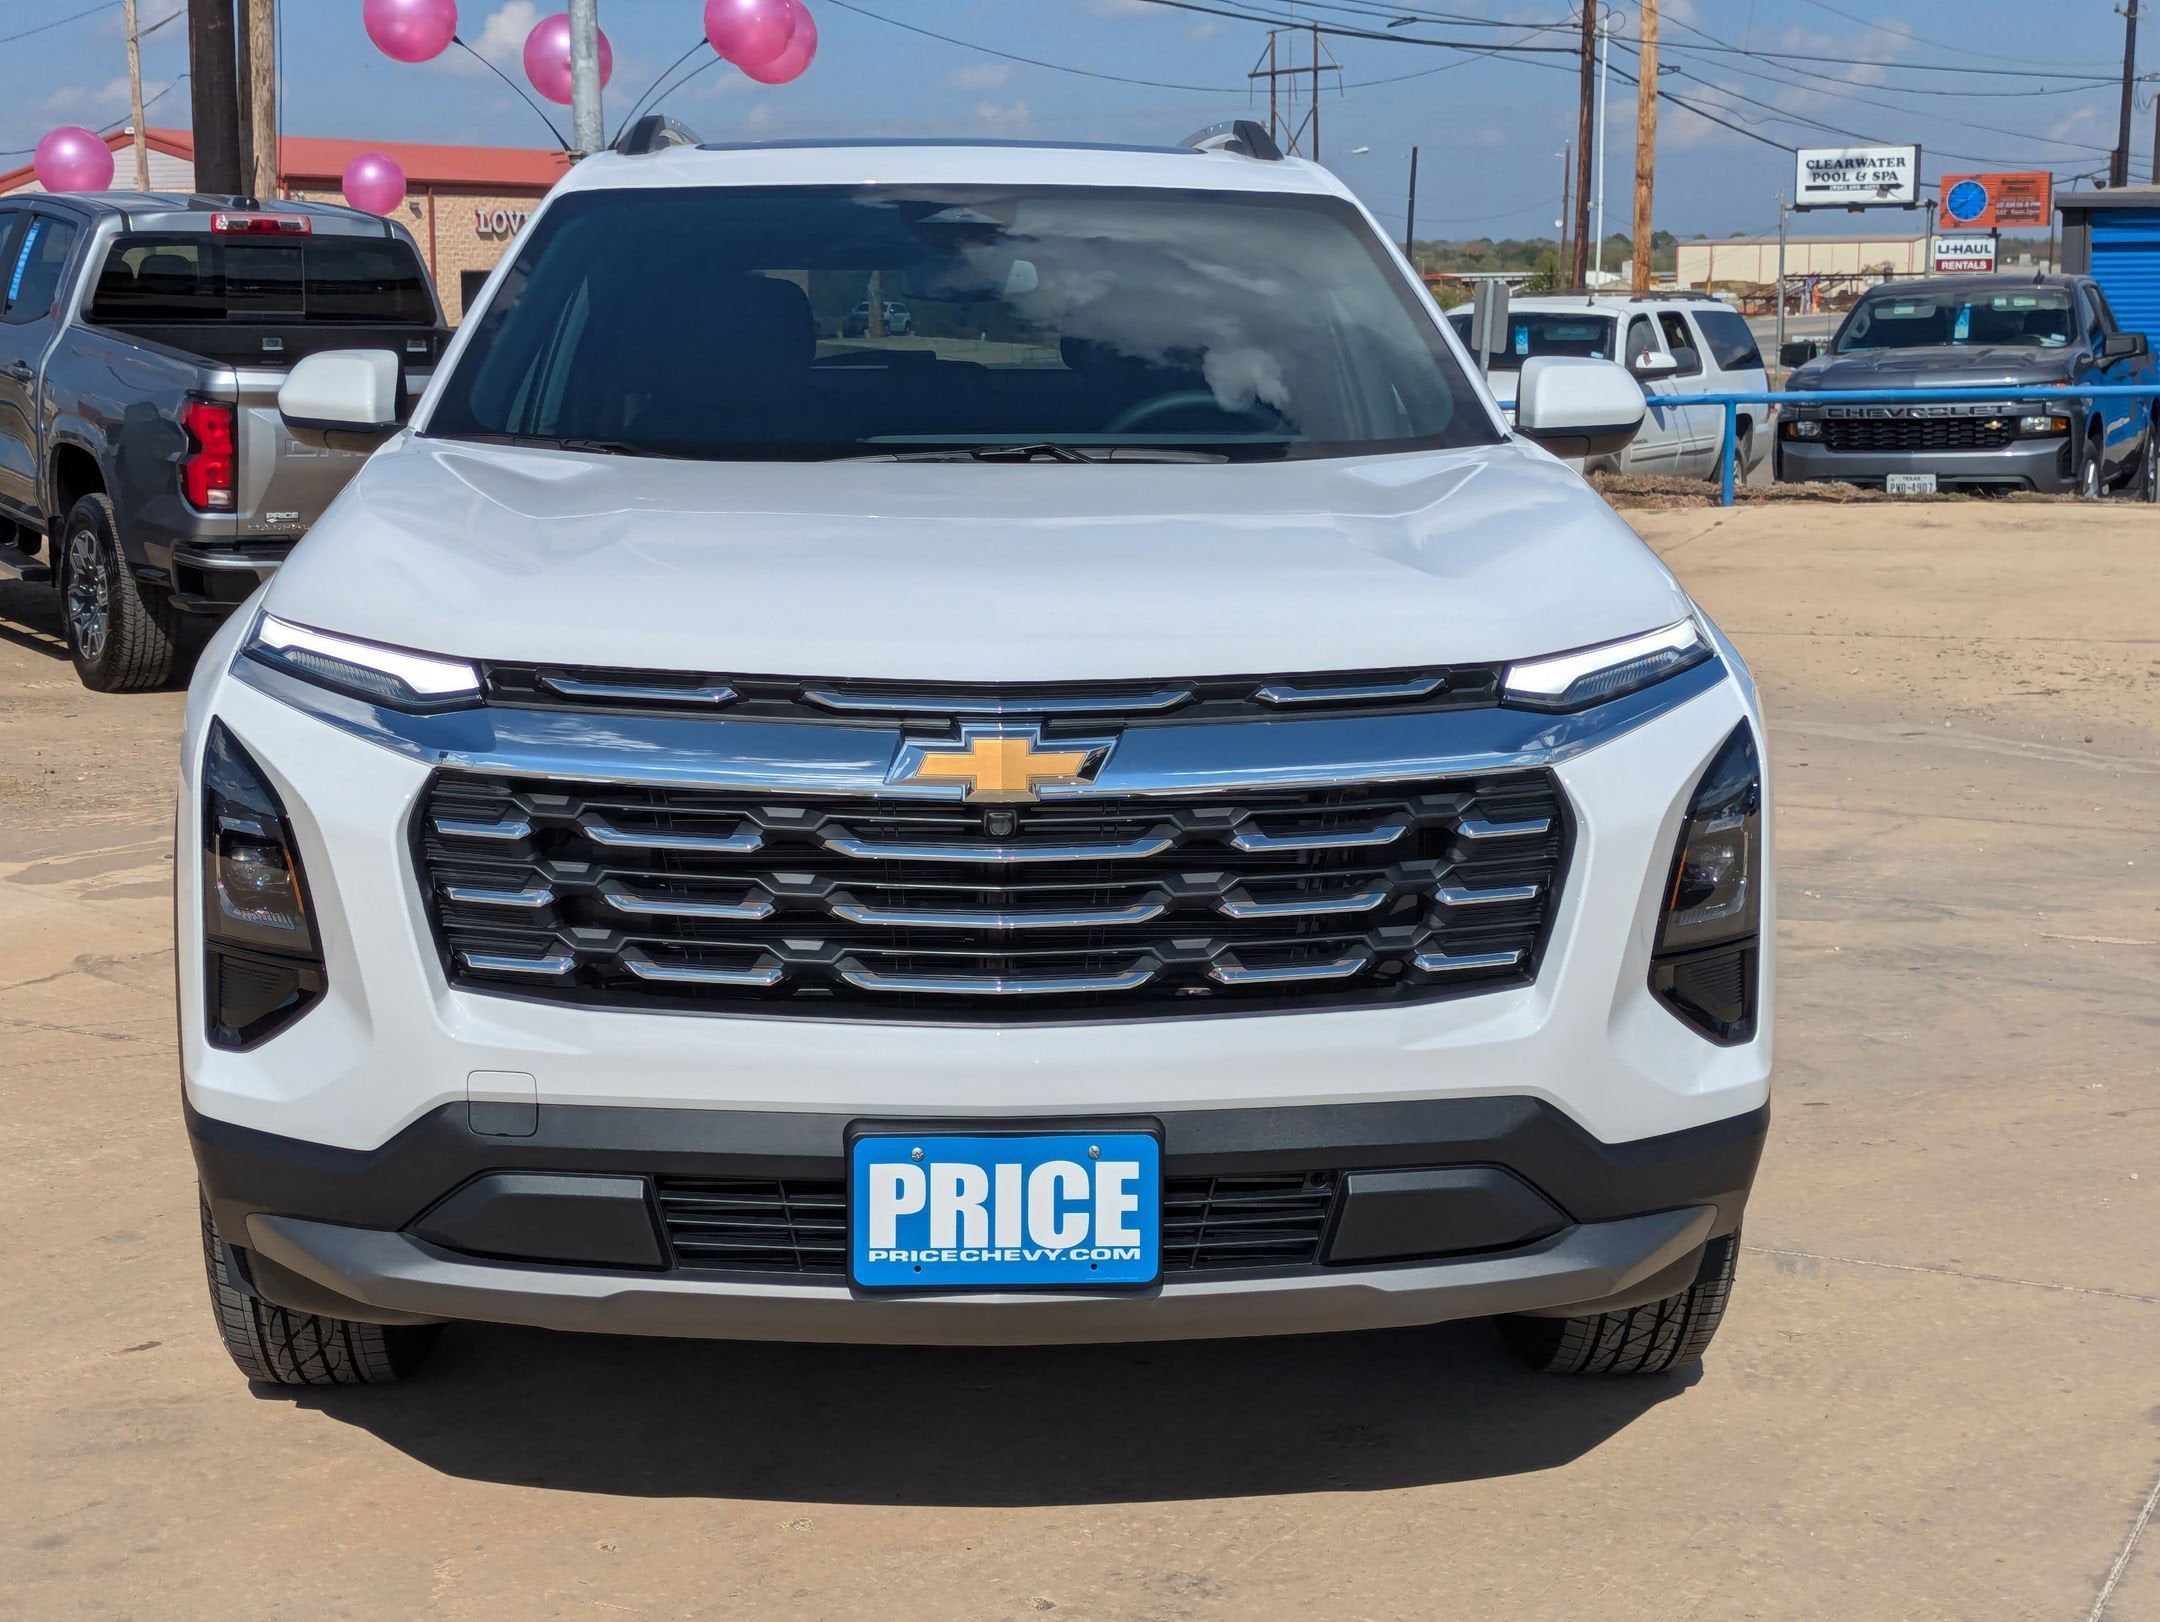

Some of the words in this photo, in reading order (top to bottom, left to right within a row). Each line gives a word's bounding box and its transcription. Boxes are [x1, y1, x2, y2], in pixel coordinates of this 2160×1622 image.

[1805, 157, 1906, 170] CLEARWATER
[1812, 172, 1850, 182] POOL
[1855, 171, 1867, 181] &
[1872, 171, 1899, 181] SPA
[1941, 260, 1987, 270] RENTALS
[1827, 406, 2010, 418] CHEVROLET
[869, 1160, 1141, 1250] PRICE
[868, 1247, 1141, 1263] PRICECHEVY.COM
